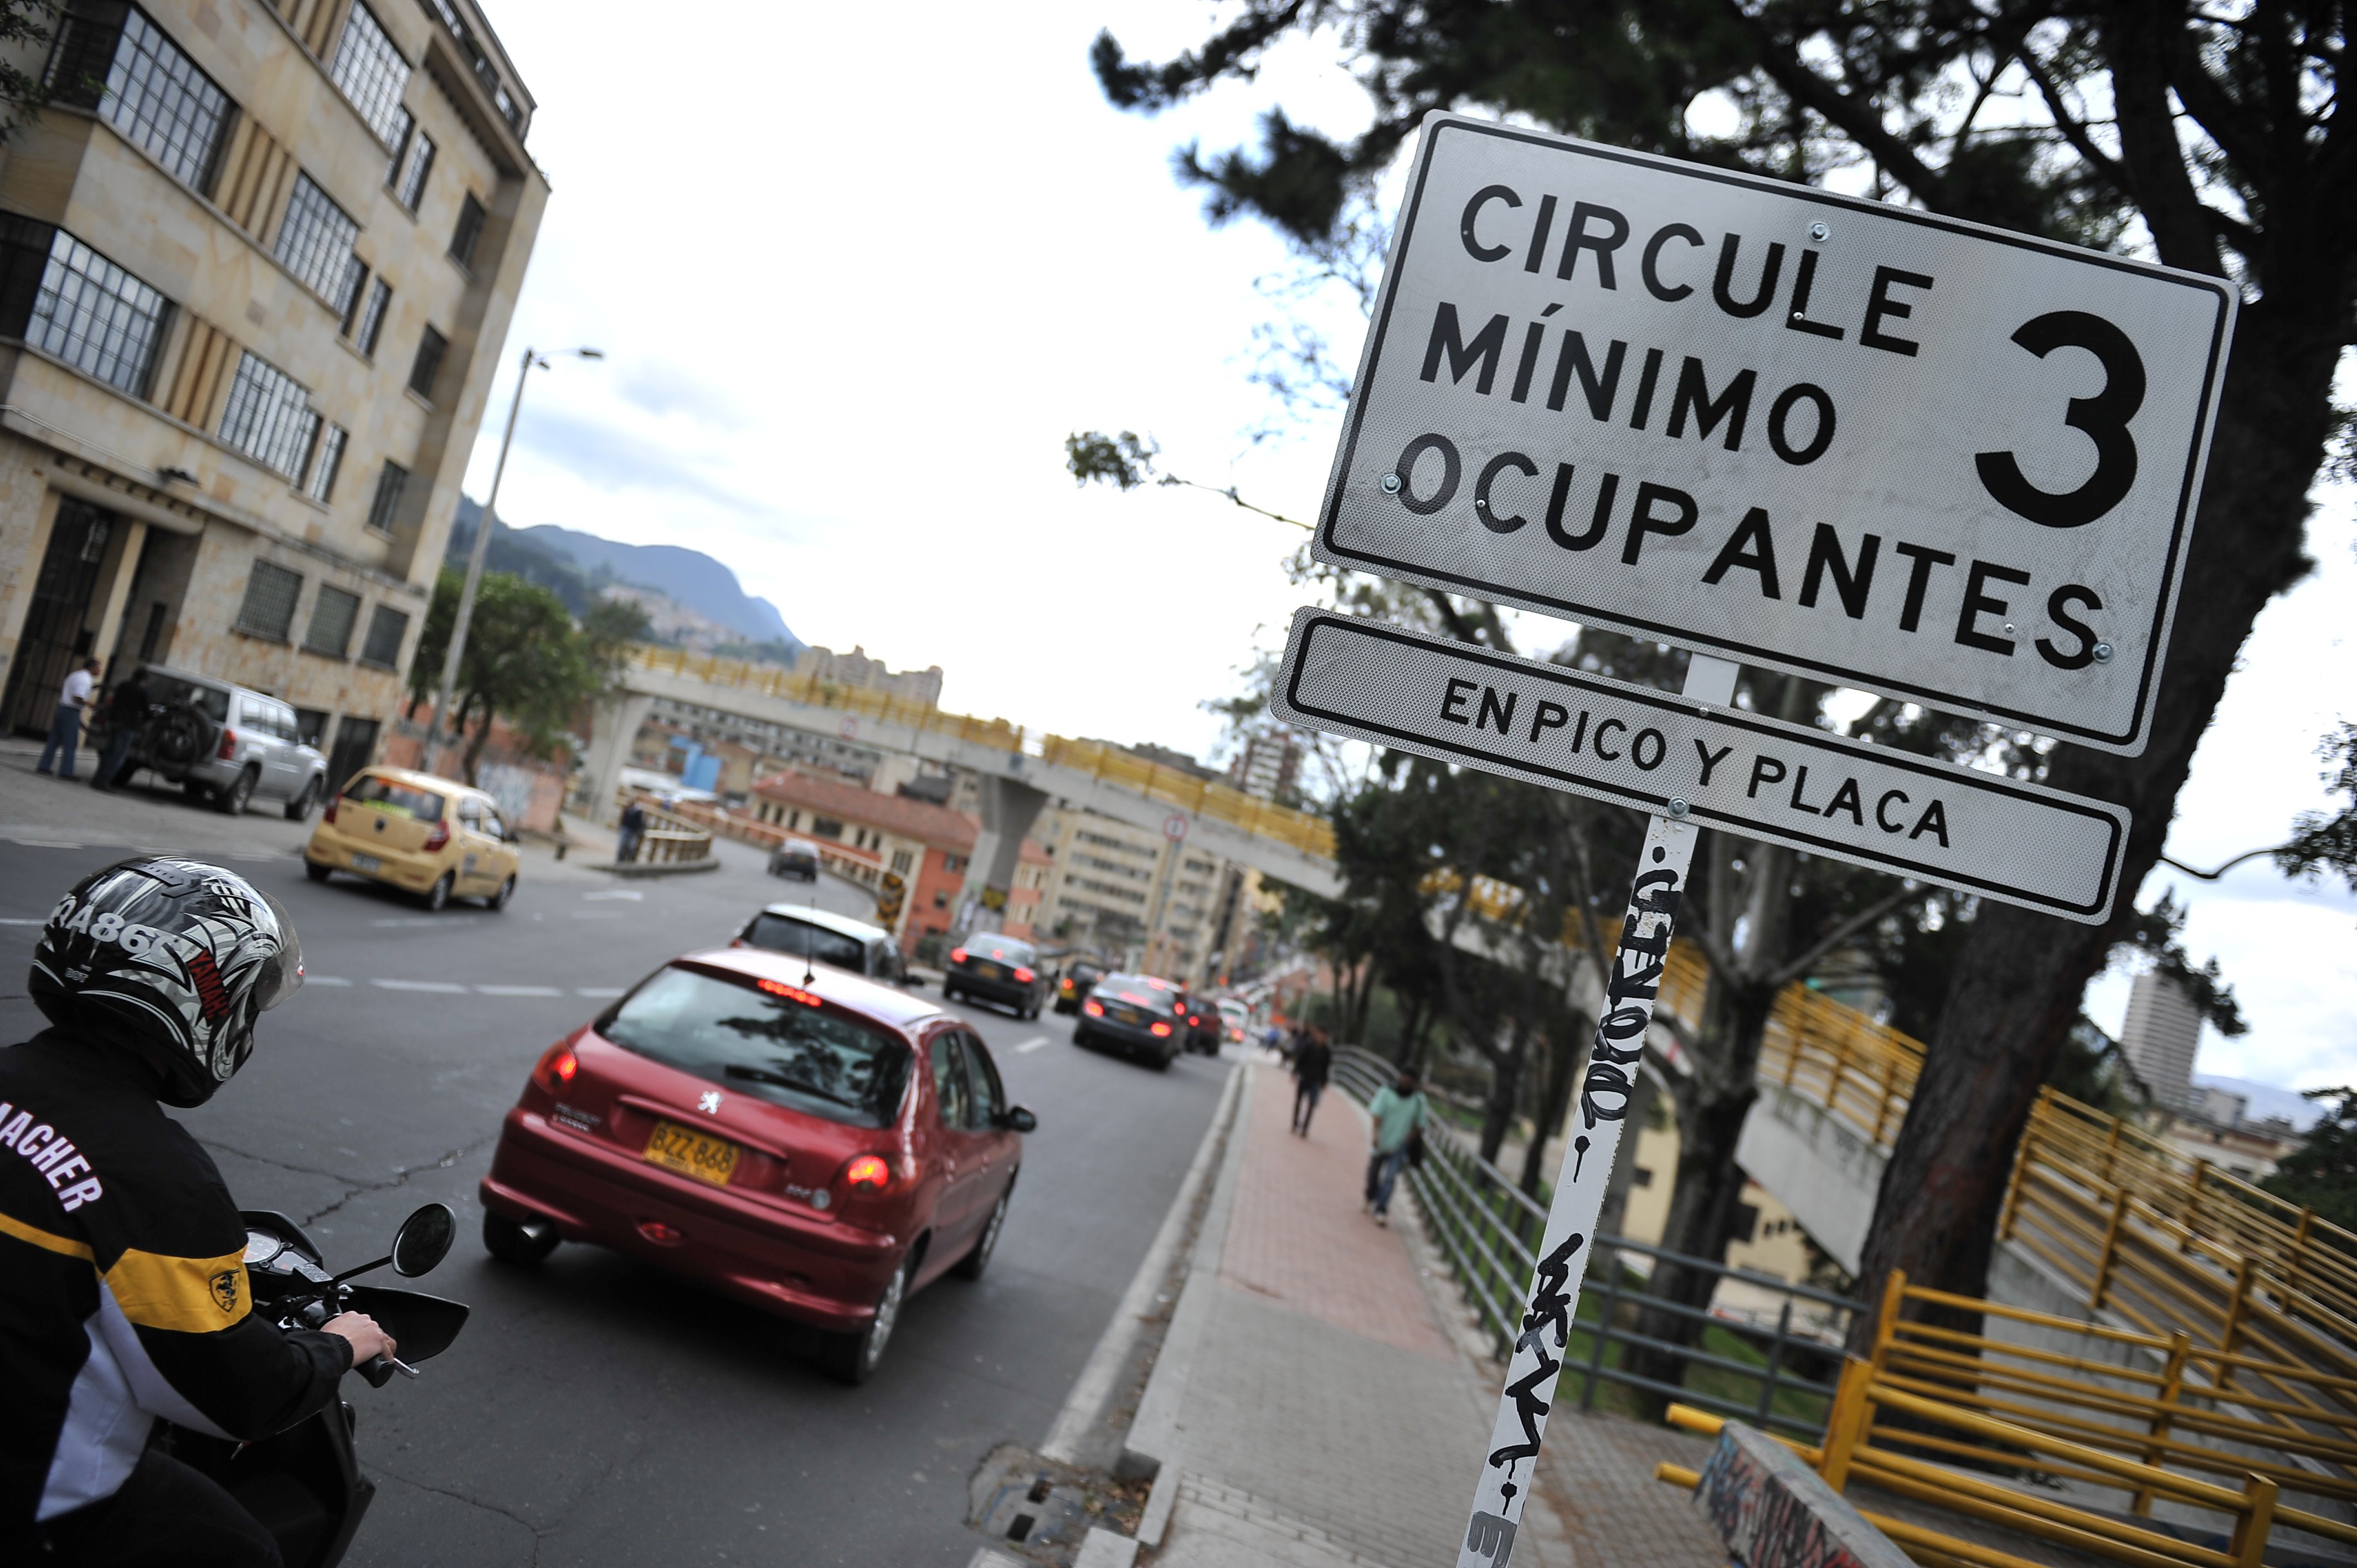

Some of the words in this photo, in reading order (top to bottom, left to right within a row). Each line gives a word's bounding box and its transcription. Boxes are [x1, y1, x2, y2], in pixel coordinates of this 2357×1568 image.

[1460, 184, 1934, 358] CIRCULE
[1419, 302, 1837, 466] MÍNIMO
[1975, 311, 2147, 528] 3
[1395, 432, 2103, 670] OCUPANTES
[1441, 678, 1517, 735] EN
[1530, 700, 1666, 771] PICO
[1694, 739, 1733, 786] Y
[1747, 755, 1950, 848] PLACA
